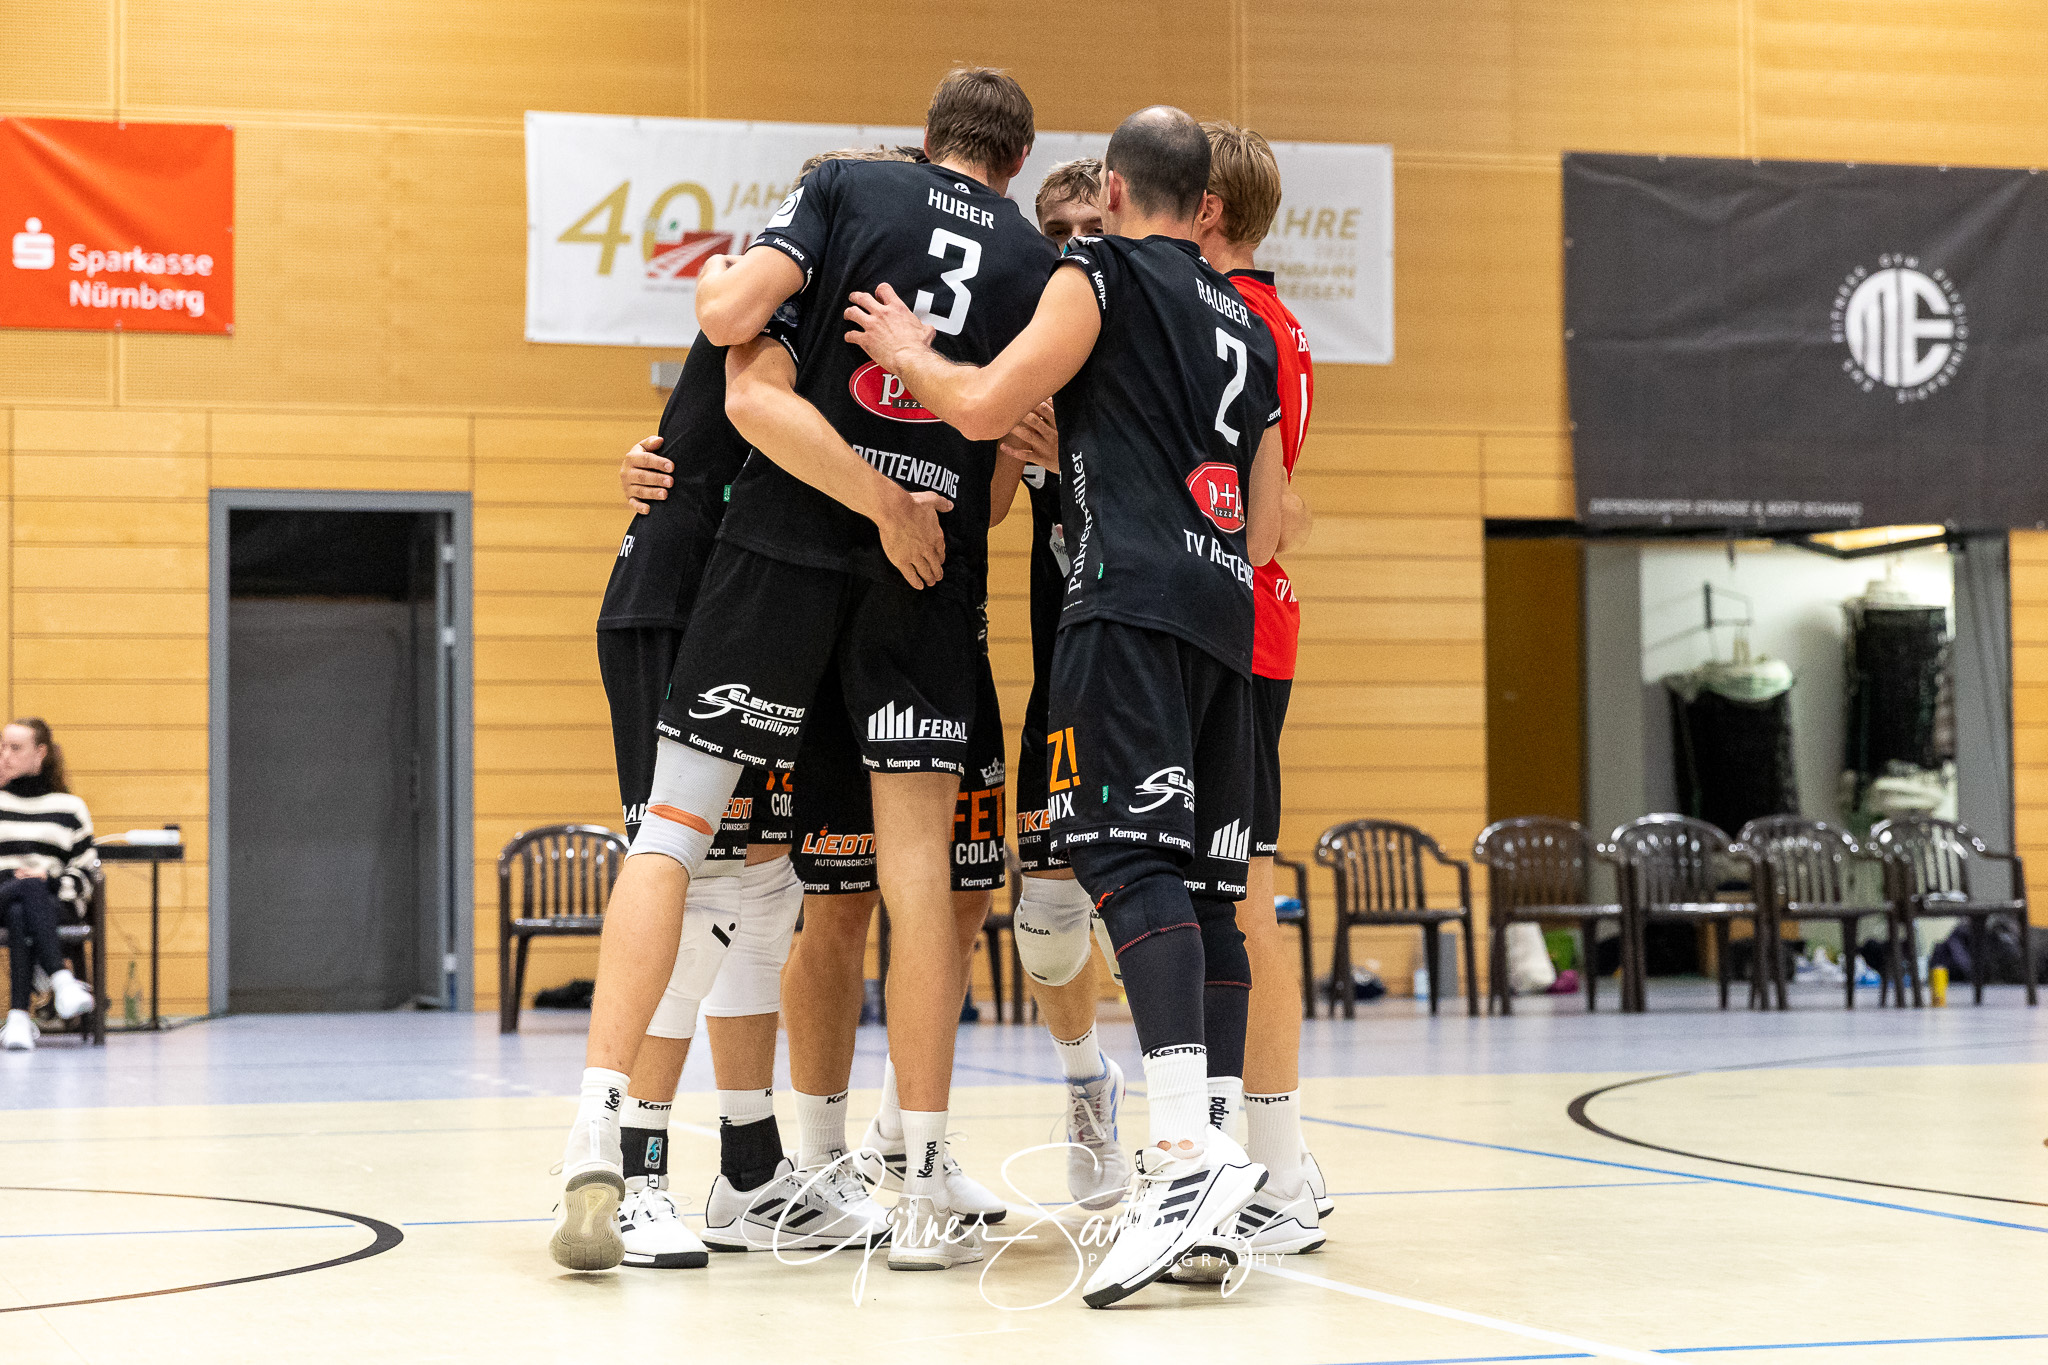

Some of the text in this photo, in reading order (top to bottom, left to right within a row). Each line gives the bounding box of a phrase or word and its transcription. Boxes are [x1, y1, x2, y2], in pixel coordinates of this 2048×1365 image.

[928, 187, 994, 229] HUBER
[557, 179, 716, 277] 40
[68, 243, 214, 277] Sparkasse
[772, 237, 805, 261] Kempa
[913, 227, 982, 336] 3
[69, 279, 205, 317] Nürnberg
[1195, 277, 1251, 329] RAUBER
[1214, 327, 1248, 446] 2
[1183, 528, 1206, 557] TV
[727, 688, 806, 718] ELEKTRO
[740, 712, 800, 737] Sanfilippo
[917, 718, 968, 740] FERAL
[656, 720, 682, 738] Kempa
[688, 732, 724, 754] Kempa
[732, 748, 767, 766] Kempa
[886, 758, 921, 770] Kempa
[931, 757, 957, 771] Kempa
[761, 830, 787, 841] Kempa
[1065, 827, 1191, 850] Kempa Kempa Kempa
[840, 879, 872, 891] Kempa
[961, 877, 993, 889] Kempa
[1217, 880, 1246, 895] Kempa
[916, 1141, 938, 1179] Kempa
